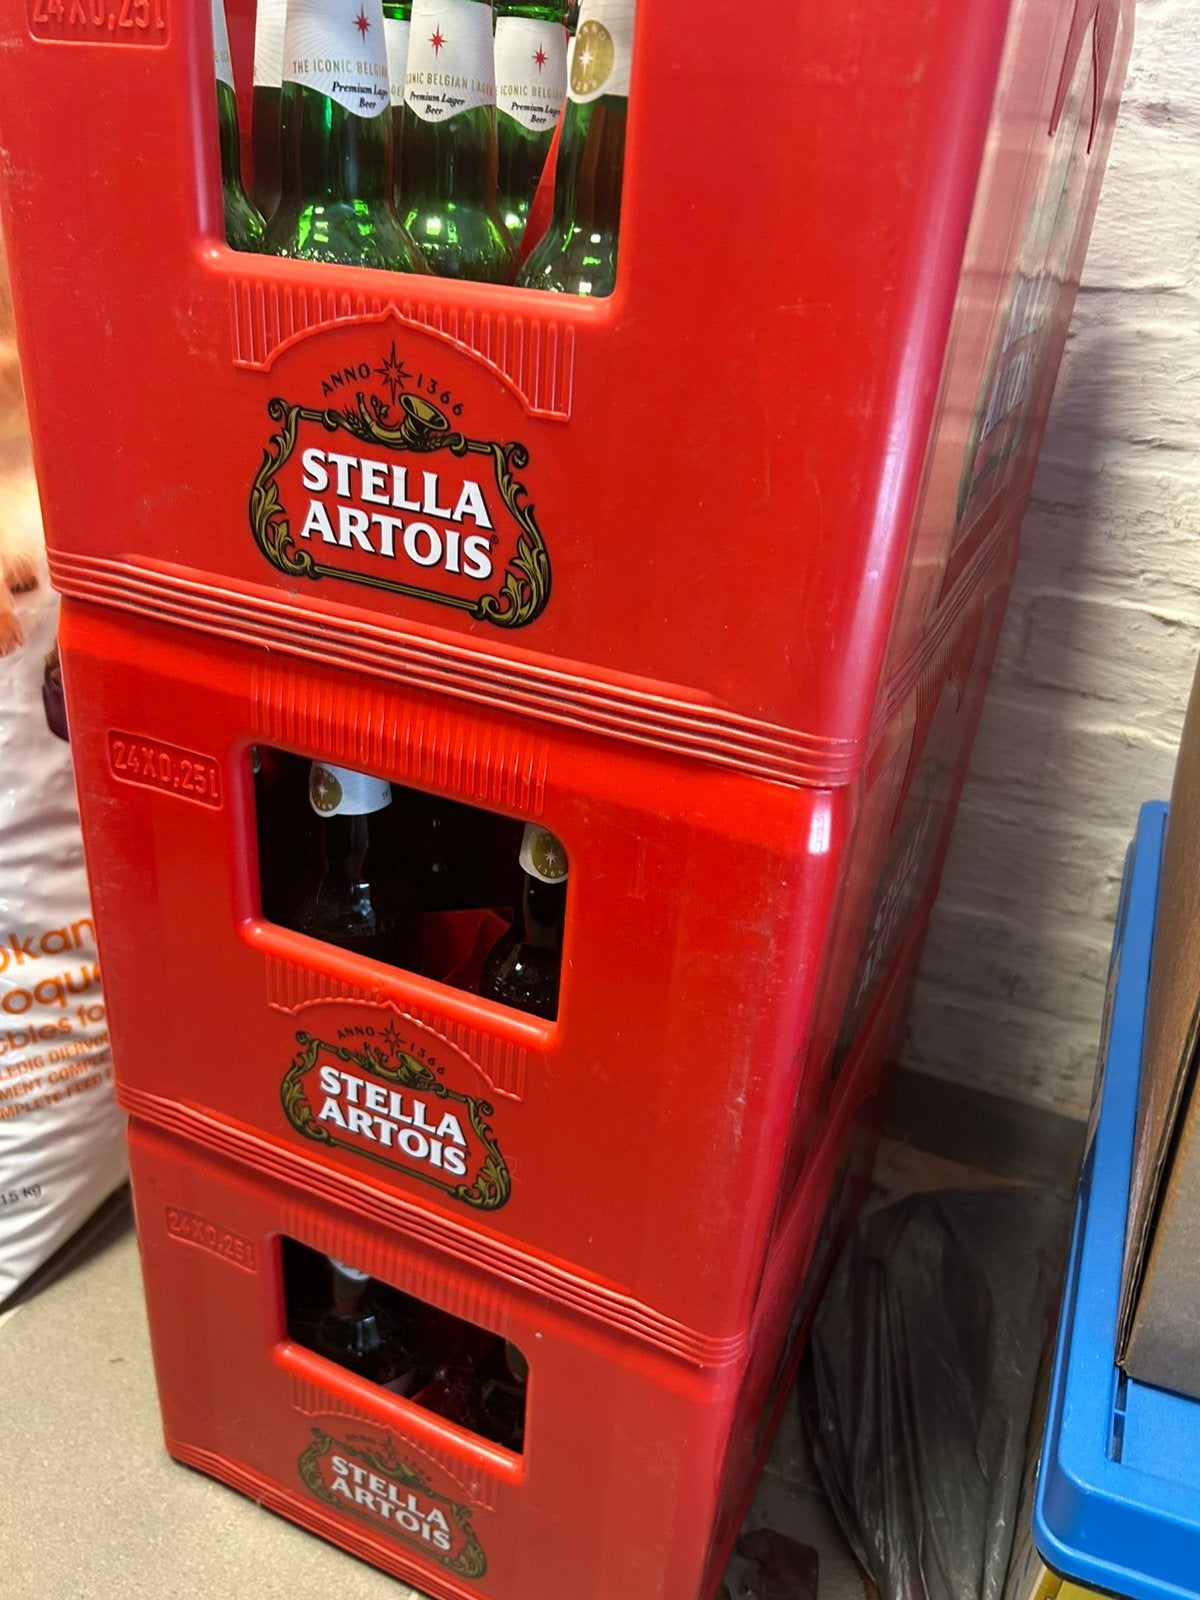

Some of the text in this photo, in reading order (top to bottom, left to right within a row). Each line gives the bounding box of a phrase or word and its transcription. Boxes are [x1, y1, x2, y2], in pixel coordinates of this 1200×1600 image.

[293, 61, 309, 75] THE
[313, 59, 351, 74] ICONIC
[427, 73, 468, 91] BELGIAN
[332, 81, 372, 95] Premium
[359, 97, 377, 109] Beer
[409, 91, 466, 107] Premium Lager
[500, 84, 528, 97] ICONIC
[425, 104, 443, 116] Beer
[511, 101, 543, 113] Premium
[530, 113, 547, 124] Beer
[320, 362, 371, 398] ANNO
[417, 372, 464, 417] 1366
[302, 447, 494, 530] STELLA
[300, 498, 493, 580] ARTOIS
[0, 918, 96, 974] kan
[2, 963, 101, 1015] oqu
[336, 1026, 375, 1040] ANNO
[410, 1042, 446, 1075] 1366
[320, 1065, 468, 1147] STELLA
[318, 1096, 468, 1176] ARTOIS
[331, 1455, 450, 1532] STELLA
[330, 1476, 450, 1550] ARTOIS
